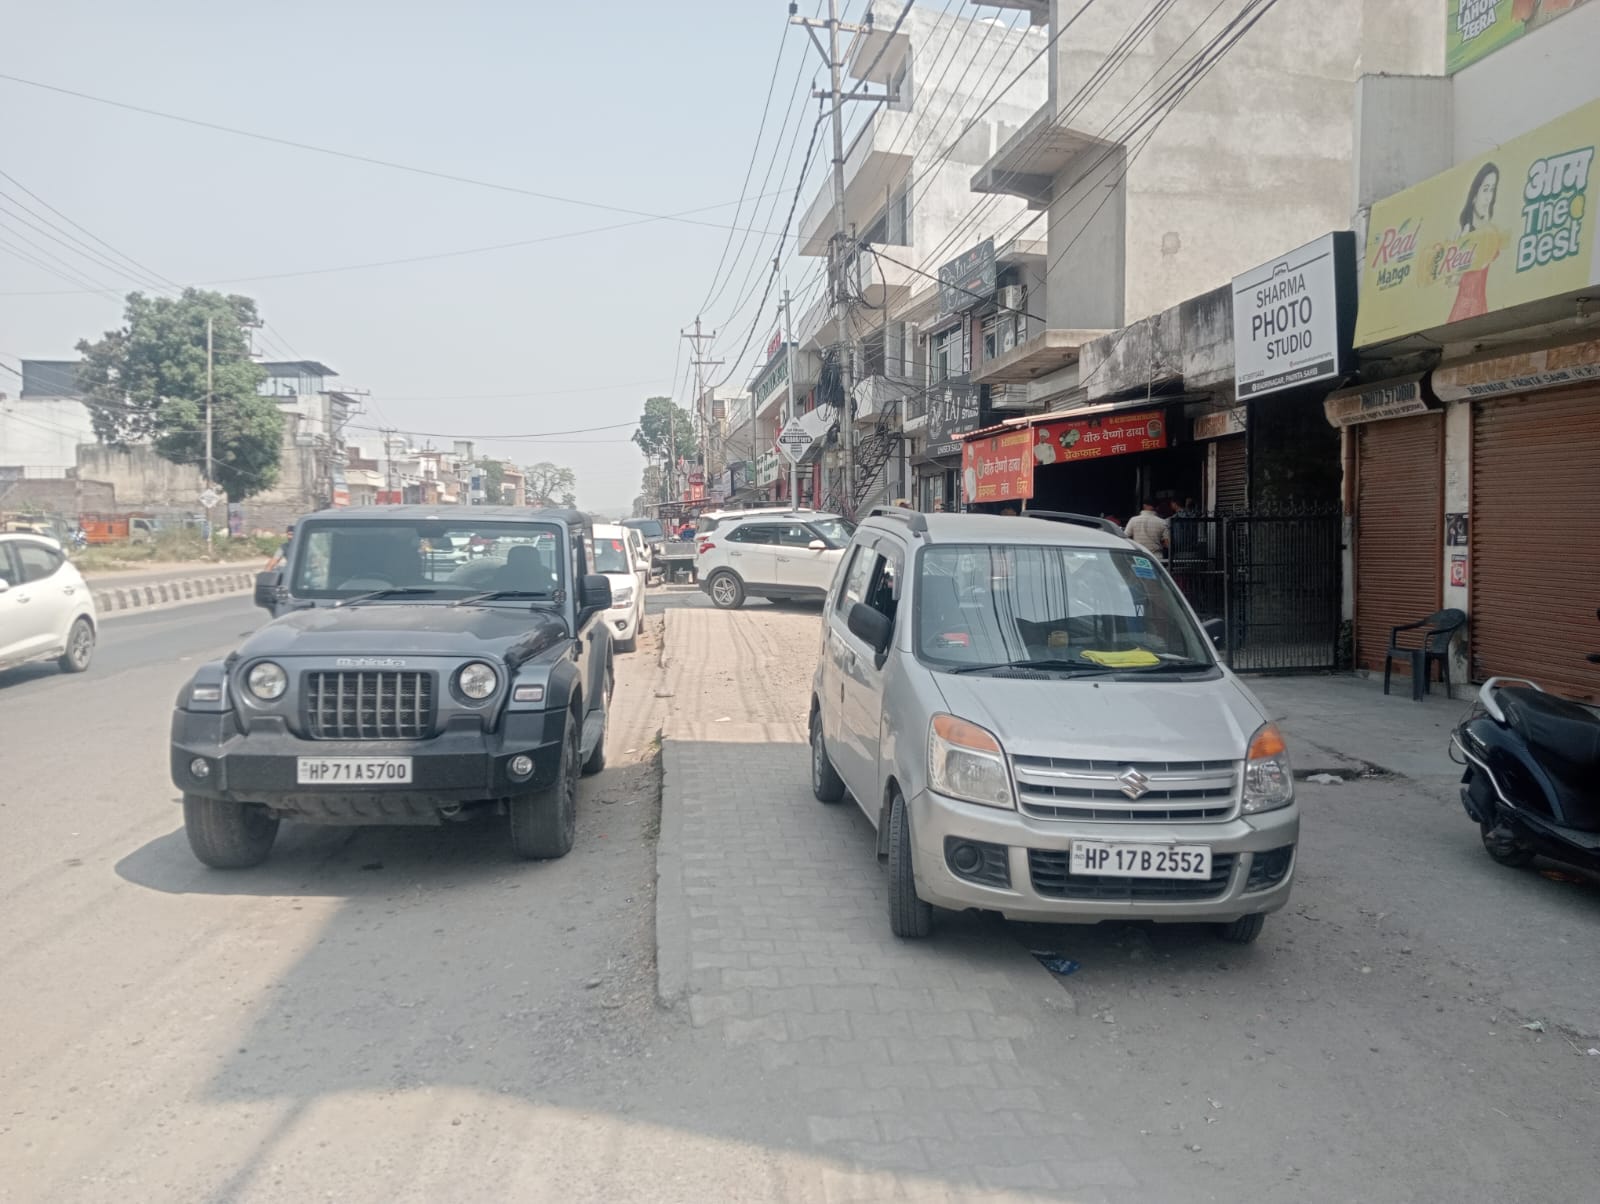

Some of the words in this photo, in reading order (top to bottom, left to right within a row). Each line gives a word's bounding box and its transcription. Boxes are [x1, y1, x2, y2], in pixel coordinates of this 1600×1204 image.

[1457, 0, 1501, 30] LAHOR
[1462, 8, 1496, 41] ZEERA
[1525, 148, 1594, 200] आम
[1523, 197, 1569, 235] The
[1372, 217, 1424, 268] Real
[1438, 244, 1478, 274] Real
[1517, 221, 1581, 271] Best
[1256, 273, 1306, 309] SHARMA
[1376, 264, 1410, 287] Mango
[1252, 295, 1312, 342] PHOTO
[1266, 329, 1312, 360] STUDIO
[1303, 367, 1318, 378] SAHIB
